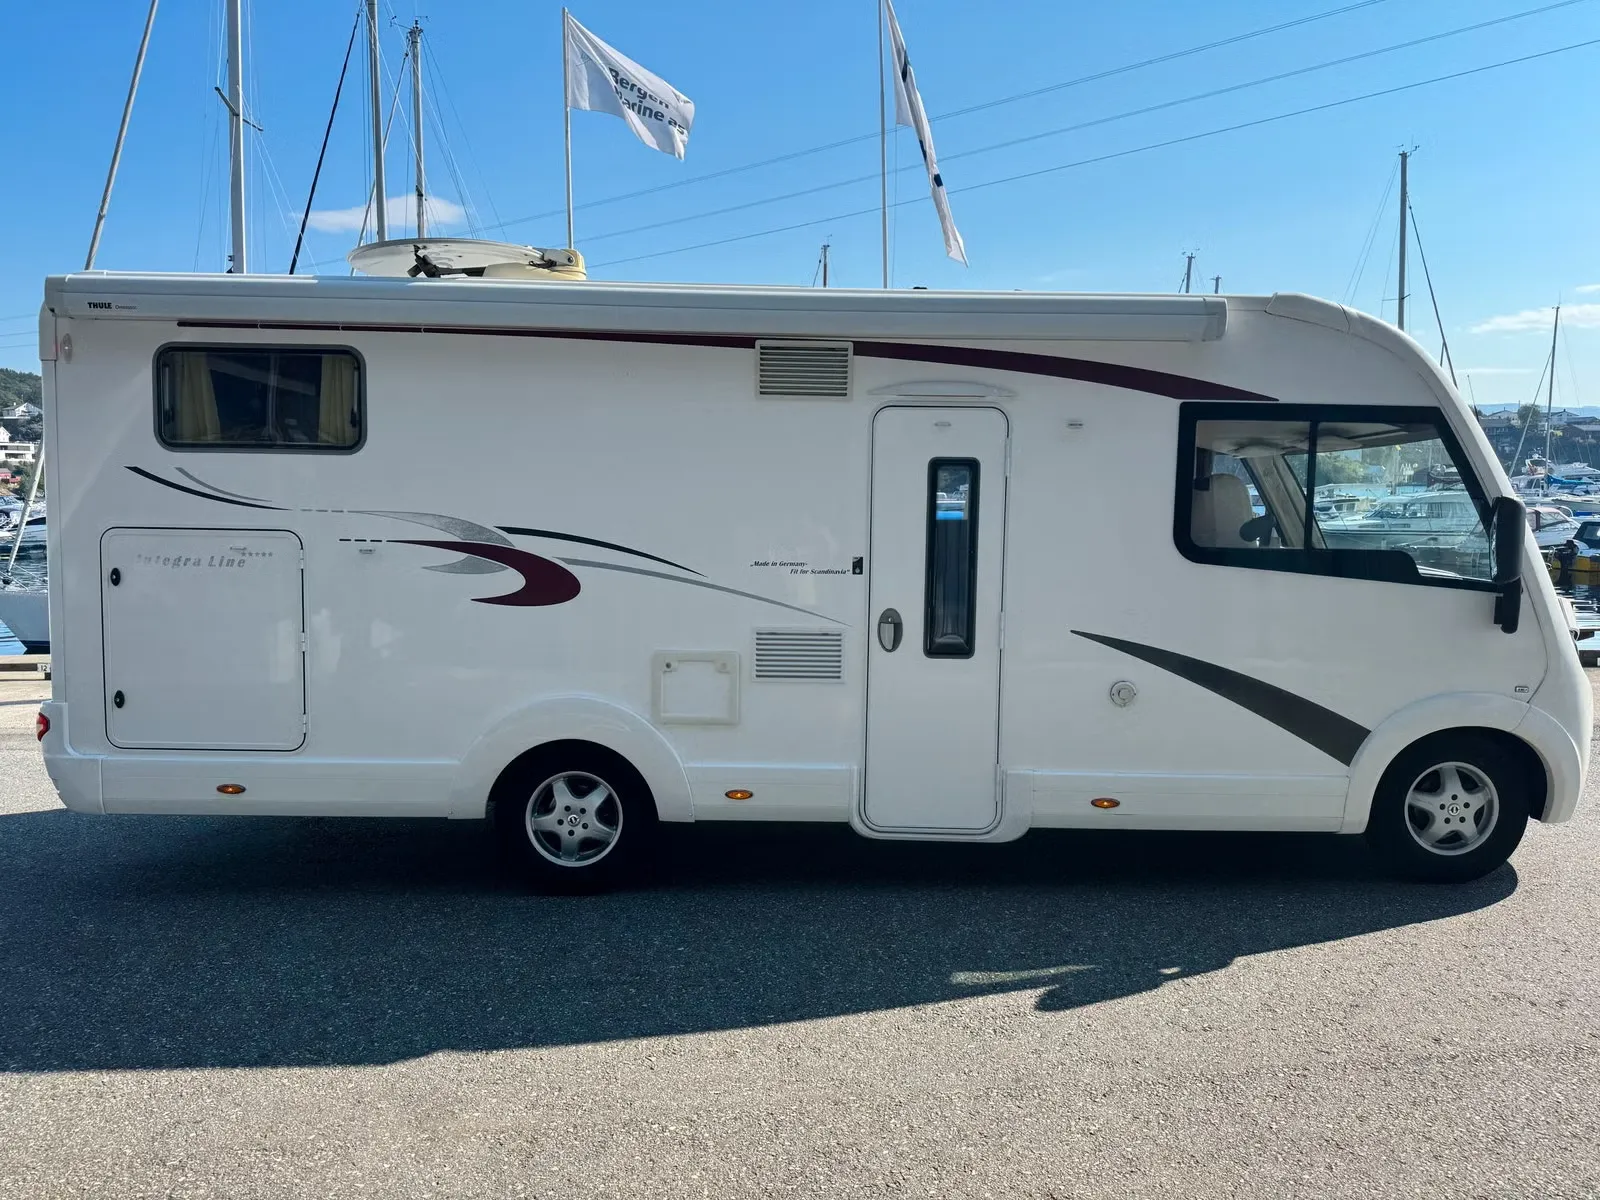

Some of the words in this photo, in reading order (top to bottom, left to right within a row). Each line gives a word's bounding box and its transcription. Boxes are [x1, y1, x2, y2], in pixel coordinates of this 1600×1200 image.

[608, 66, 669, 109] Bergen
[667, 117, 686, 135] as
[87, 301, 113, 310] THULE
[136, 554, 202, 569] ntegra
[207, 555, 246, 568] Line
